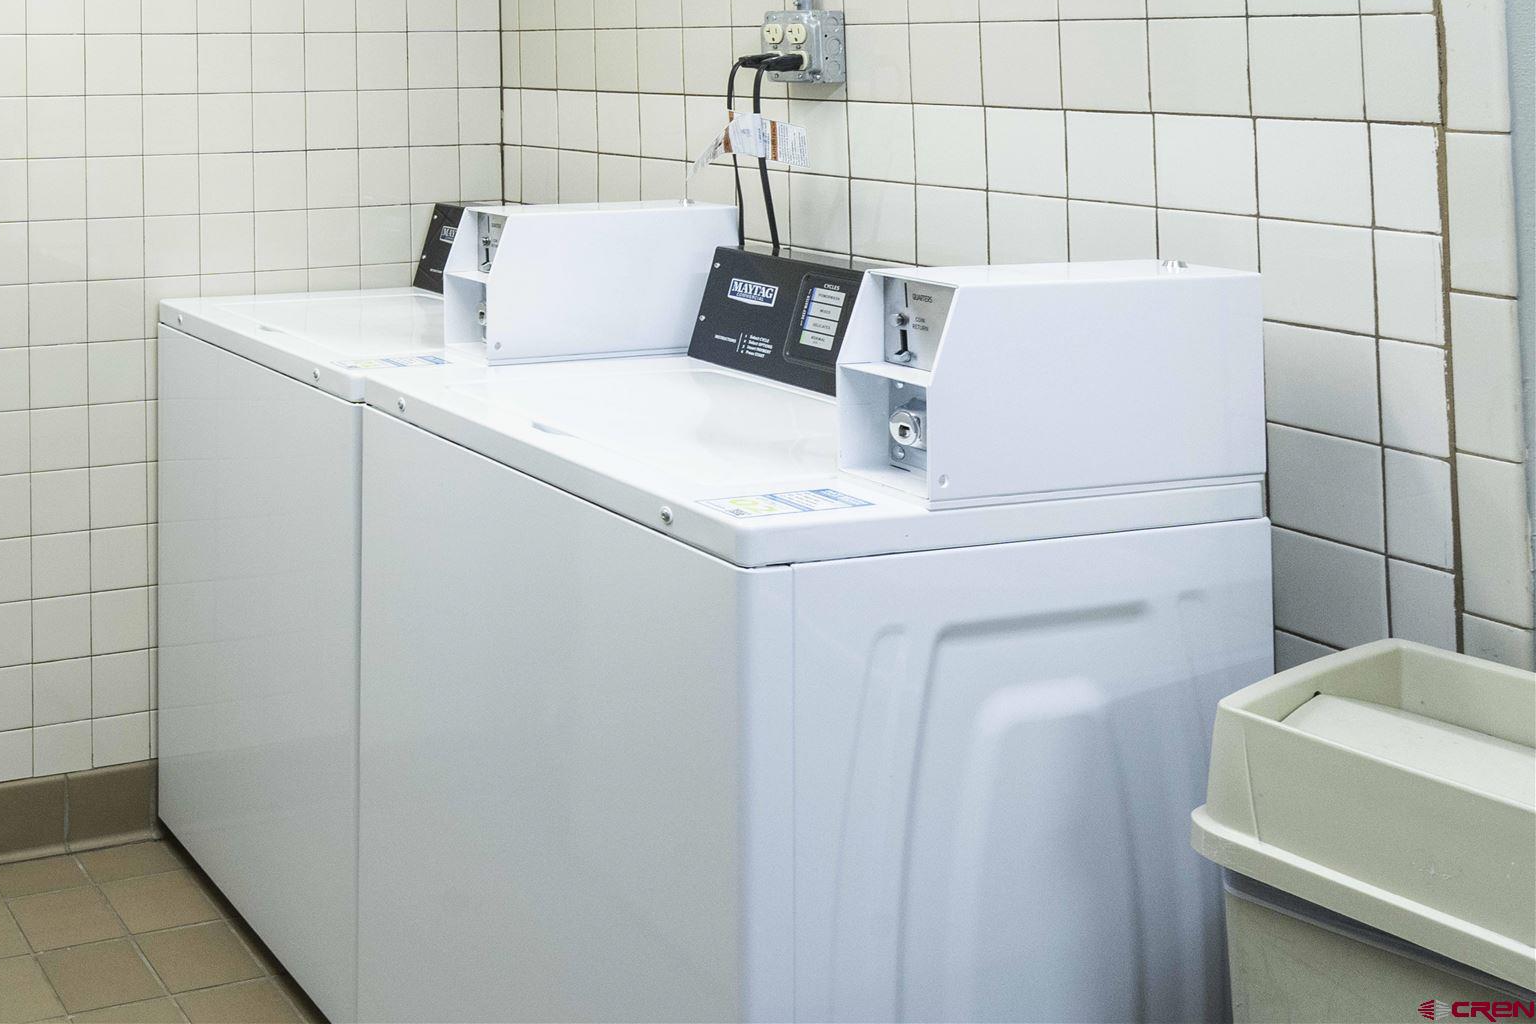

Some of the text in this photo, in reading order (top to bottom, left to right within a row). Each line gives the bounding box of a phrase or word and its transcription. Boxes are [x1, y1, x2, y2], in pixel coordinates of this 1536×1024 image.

[732, 281, 774, 298] MAYTAG
[824, 283, 840, 291] CYCLES
[912, 294, 933, 303] QUARTERS
